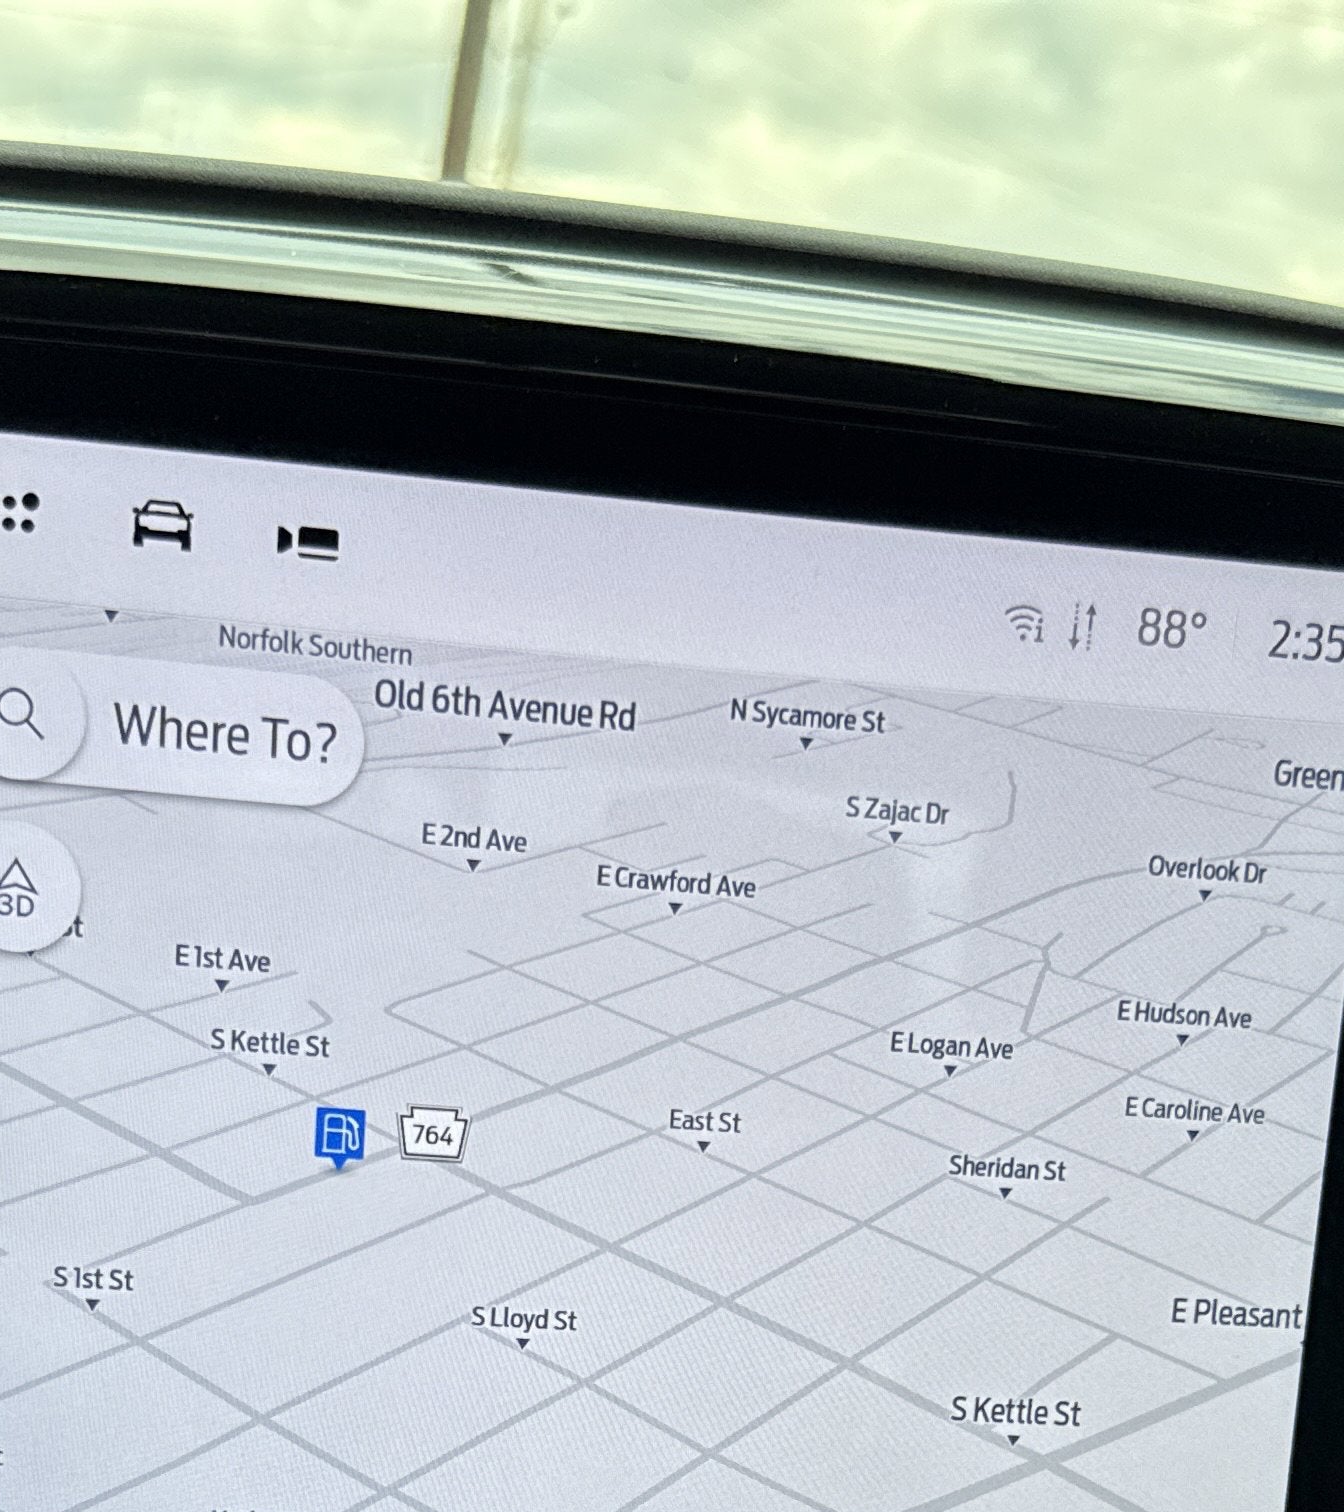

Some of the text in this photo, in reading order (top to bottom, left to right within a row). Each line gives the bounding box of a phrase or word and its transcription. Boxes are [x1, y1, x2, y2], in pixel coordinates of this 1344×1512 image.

[1138, 607, 1208, 649] 88°
[219, 624, 413, 666] Norfolk Southern
[374, 678, 637, 732] Old 6th Avenue Rd
[730, 697, 886, 734] N Sycamore St
[113, 702, 337, 764] Where To?
[845, 795, 950, 826] S Zajac Dr
[422, 822, 528, 853] E 2nd Ave
[597, 864, 756, 899] E Crawford Ave
[1148, 854, 1268, 884] Overlook Dr
[62, 914, 84, 938] t
[175, 943, 271, 973] E 1st Ave
[1117, 999, 1253, 1029] E Hudson Ave
[210, 1028, 330, 1058] S Kettle St
[890, 1031, 1014, 1060] E Logan Ave
[669, 1108, 742, 1134] East St
[1124, 1095, 1265, 1125] E Caroline Ave
[412, 1124, 453, 1146] 764
[948, 1154, 1067, 1182] Sheridan St
[53, 1265, 134, 1292] S 1st St
[471, 1305, 578, 1333] S Lloyd St
[1171, 1297, 1304, 1330] E Pleasant
[950, 1395, 1082, 1427] S Kettle St
